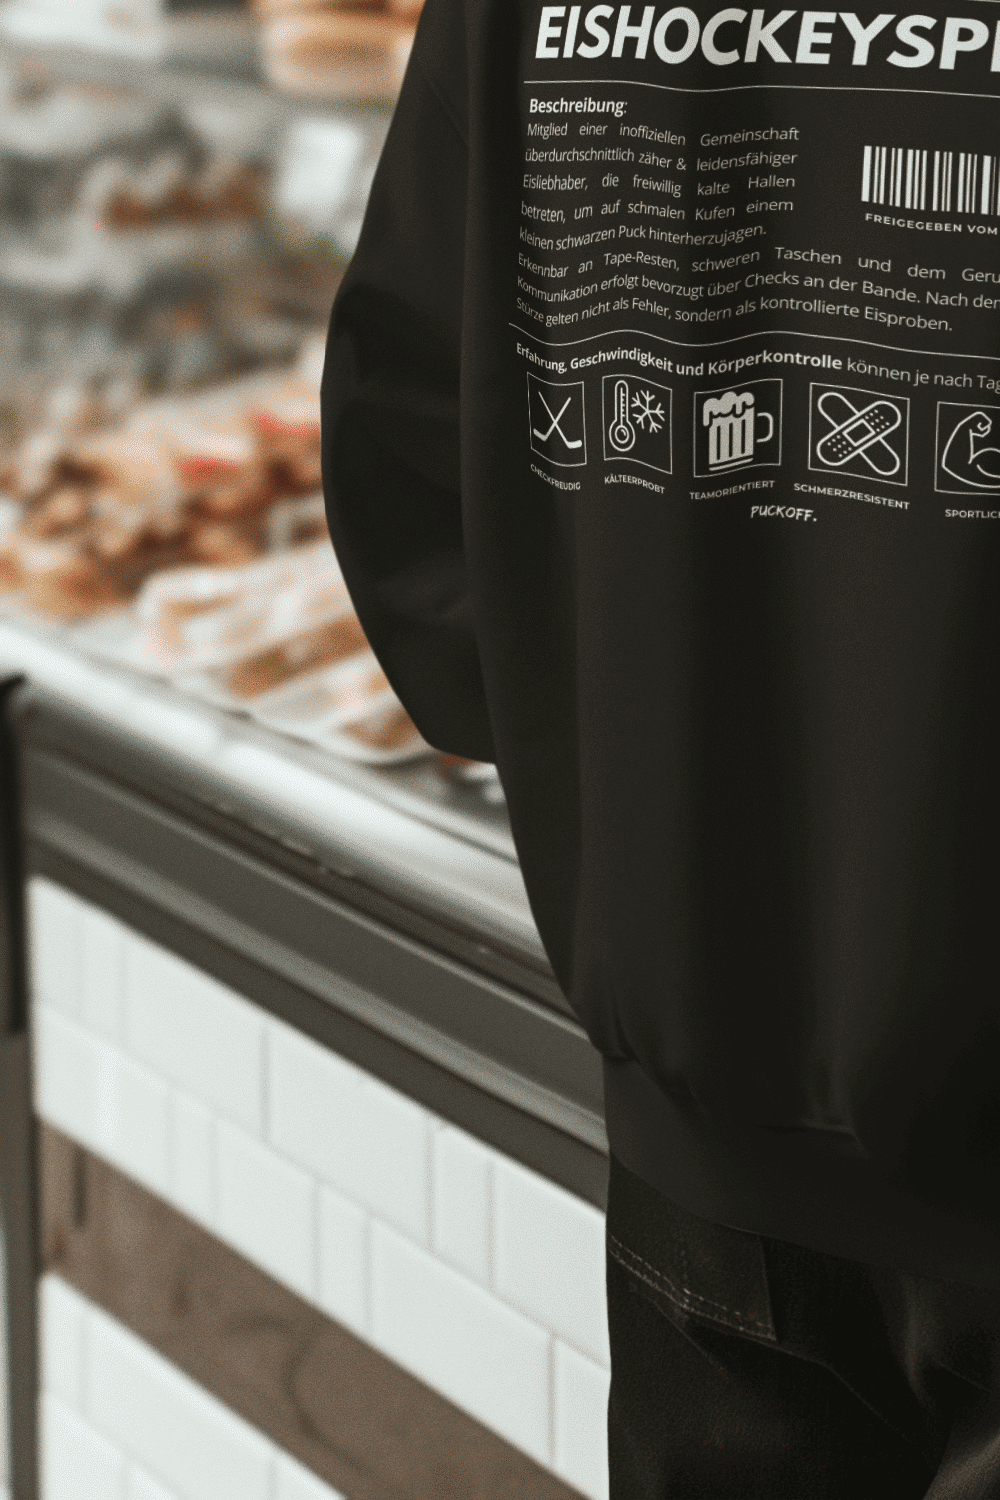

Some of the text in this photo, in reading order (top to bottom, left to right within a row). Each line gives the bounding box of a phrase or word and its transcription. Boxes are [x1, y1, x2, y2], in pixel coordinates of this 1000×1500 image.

[529, 97, 628, 118] Beschreibung:
[528, 123, 799, 146] Mitglied einer inoffiziellen Gemeinschaft
[525, 147, 798, 171] überdurchschnittlich zäher & leidensfähiger
[523, 173, 795, 198] Eisliebhaber, die freiwillig kalte Hallen
[522, 199, 793, 224] betreten, um auf schmalen Kufen einem
[865, 213, 962, 232] FREIGEGEBEN
[967, 225, 998, 235] VOM
[520, 225, 766, 250] kleinen schwarzen Puck hinterherzujagen.
[519, 253, 569, 278] Erkennbar
[578, 261, 593, 273] an
[604, 251, 679, 271] Tape-Resten,
[692, 252, 759, 271] schweren
[775, 247, 841, 264] Taschen
[858, 258, 891, 272] und
[907, 264, 945, 279] dem
[517, 276, 598, 303] Kommunikation
[601, 274, 639, 290] erfolgt
[642, 275, 703, 300] bevorzugt
[707, 280, 742, 297] über
[745, 271, 799, 287] Checks
[803, 277, 824, 288] an
[829, 277, 858, 291] der
[862, 281, 920, 303] Bande.
[926, 291, 968, 306] Nach
[517, 297, 952, 331] Stürze gelten nicht als Fehler, sondern als kontrollierte Eisproben.
[517, 343, 567, 374] Erfahrung,
[570, 347, 673, 373] Geschwindigkeit
[676, 363, 704, 376] und
[708, 350, 842, 375] Körperkontrolle
[847, 357, 910, 381] können
[913, 370, 929, 386] je
[934, 374, 972, 387] nach
[531, 464, 581, 490] CHECKFREUDIG
[604, 474, 665, 494] KÄLTEERPROBT
[690, 480, 775, 499] TEAMORIENTIERT
[794, 483, 910, 510] SCHMERZRESISTENT
[751, 505, 817, 522] PUCKOFF.
